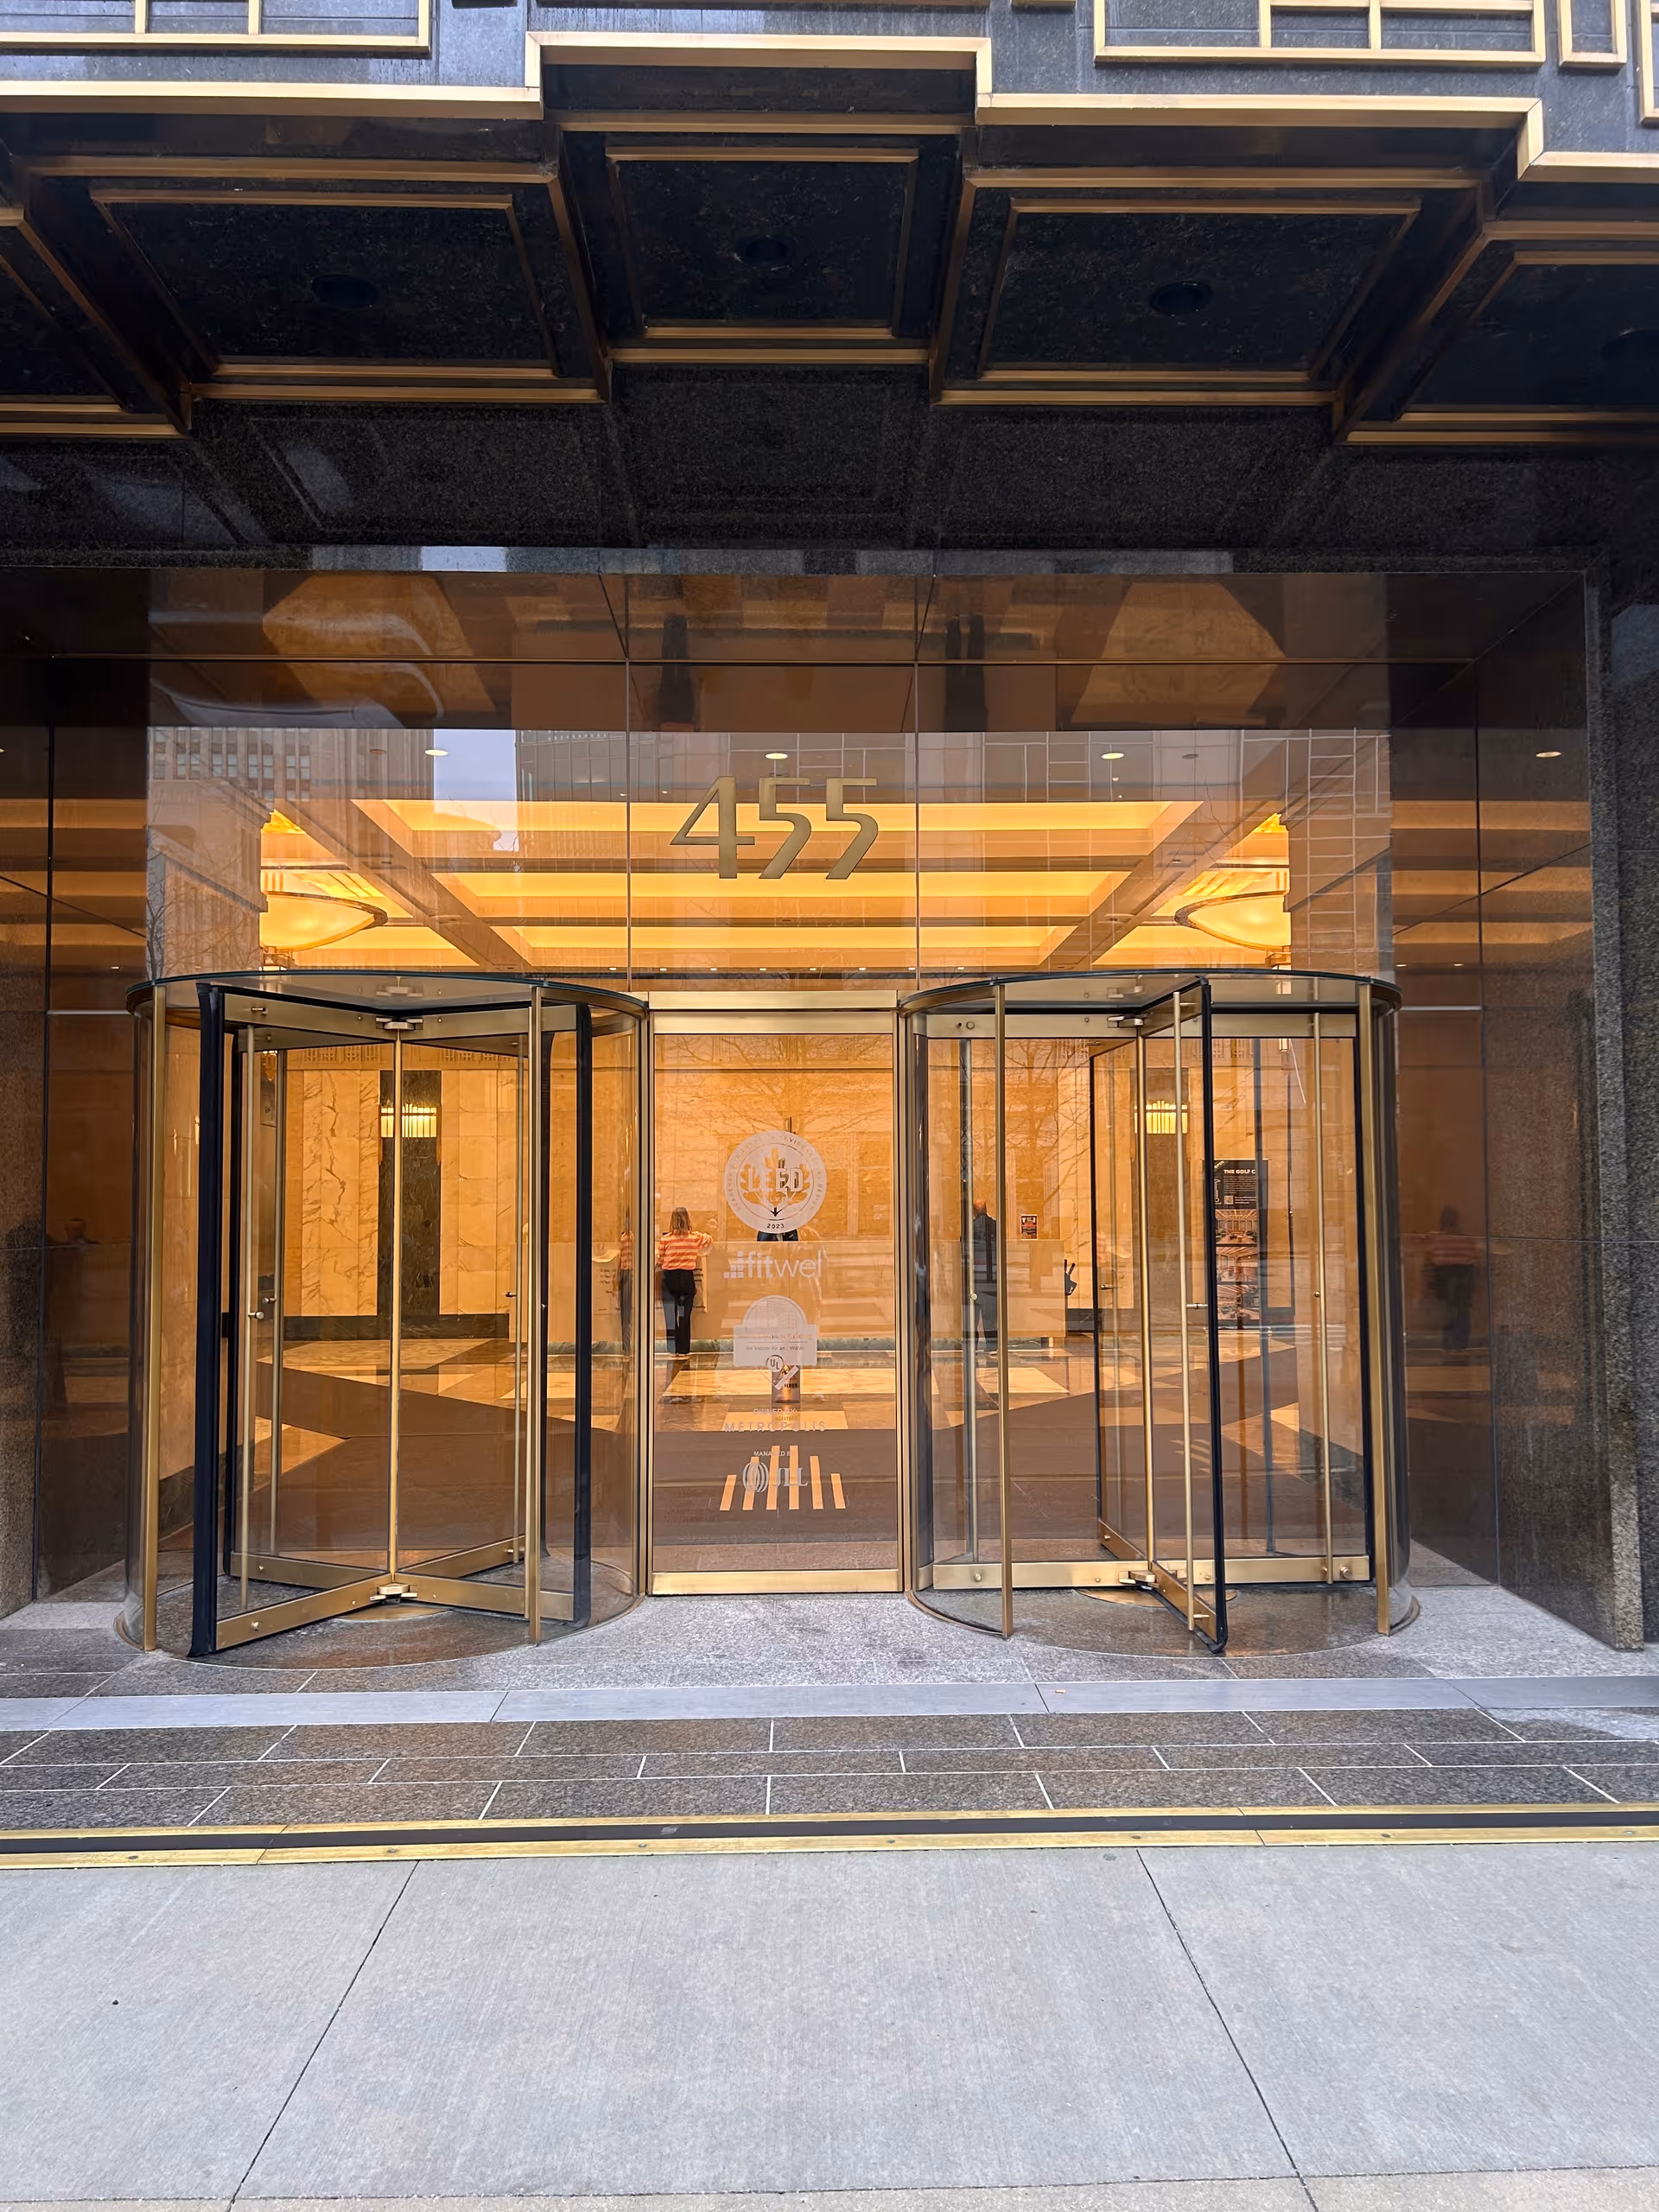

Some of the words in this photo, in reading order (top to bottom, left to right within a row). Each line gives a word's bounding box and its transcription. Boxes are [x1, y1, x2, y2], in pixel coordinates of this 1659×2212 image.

[670, 776, 879, 880] 455
[748, 1167, 804, 1192] LEED
[747, 1249, 821, 1278] fitwel
[771, 1359, 780, 1370] UL
[724, 1421, 826, 1432] METROPOLIS
[771, 1467, 809, 1486] JLL
